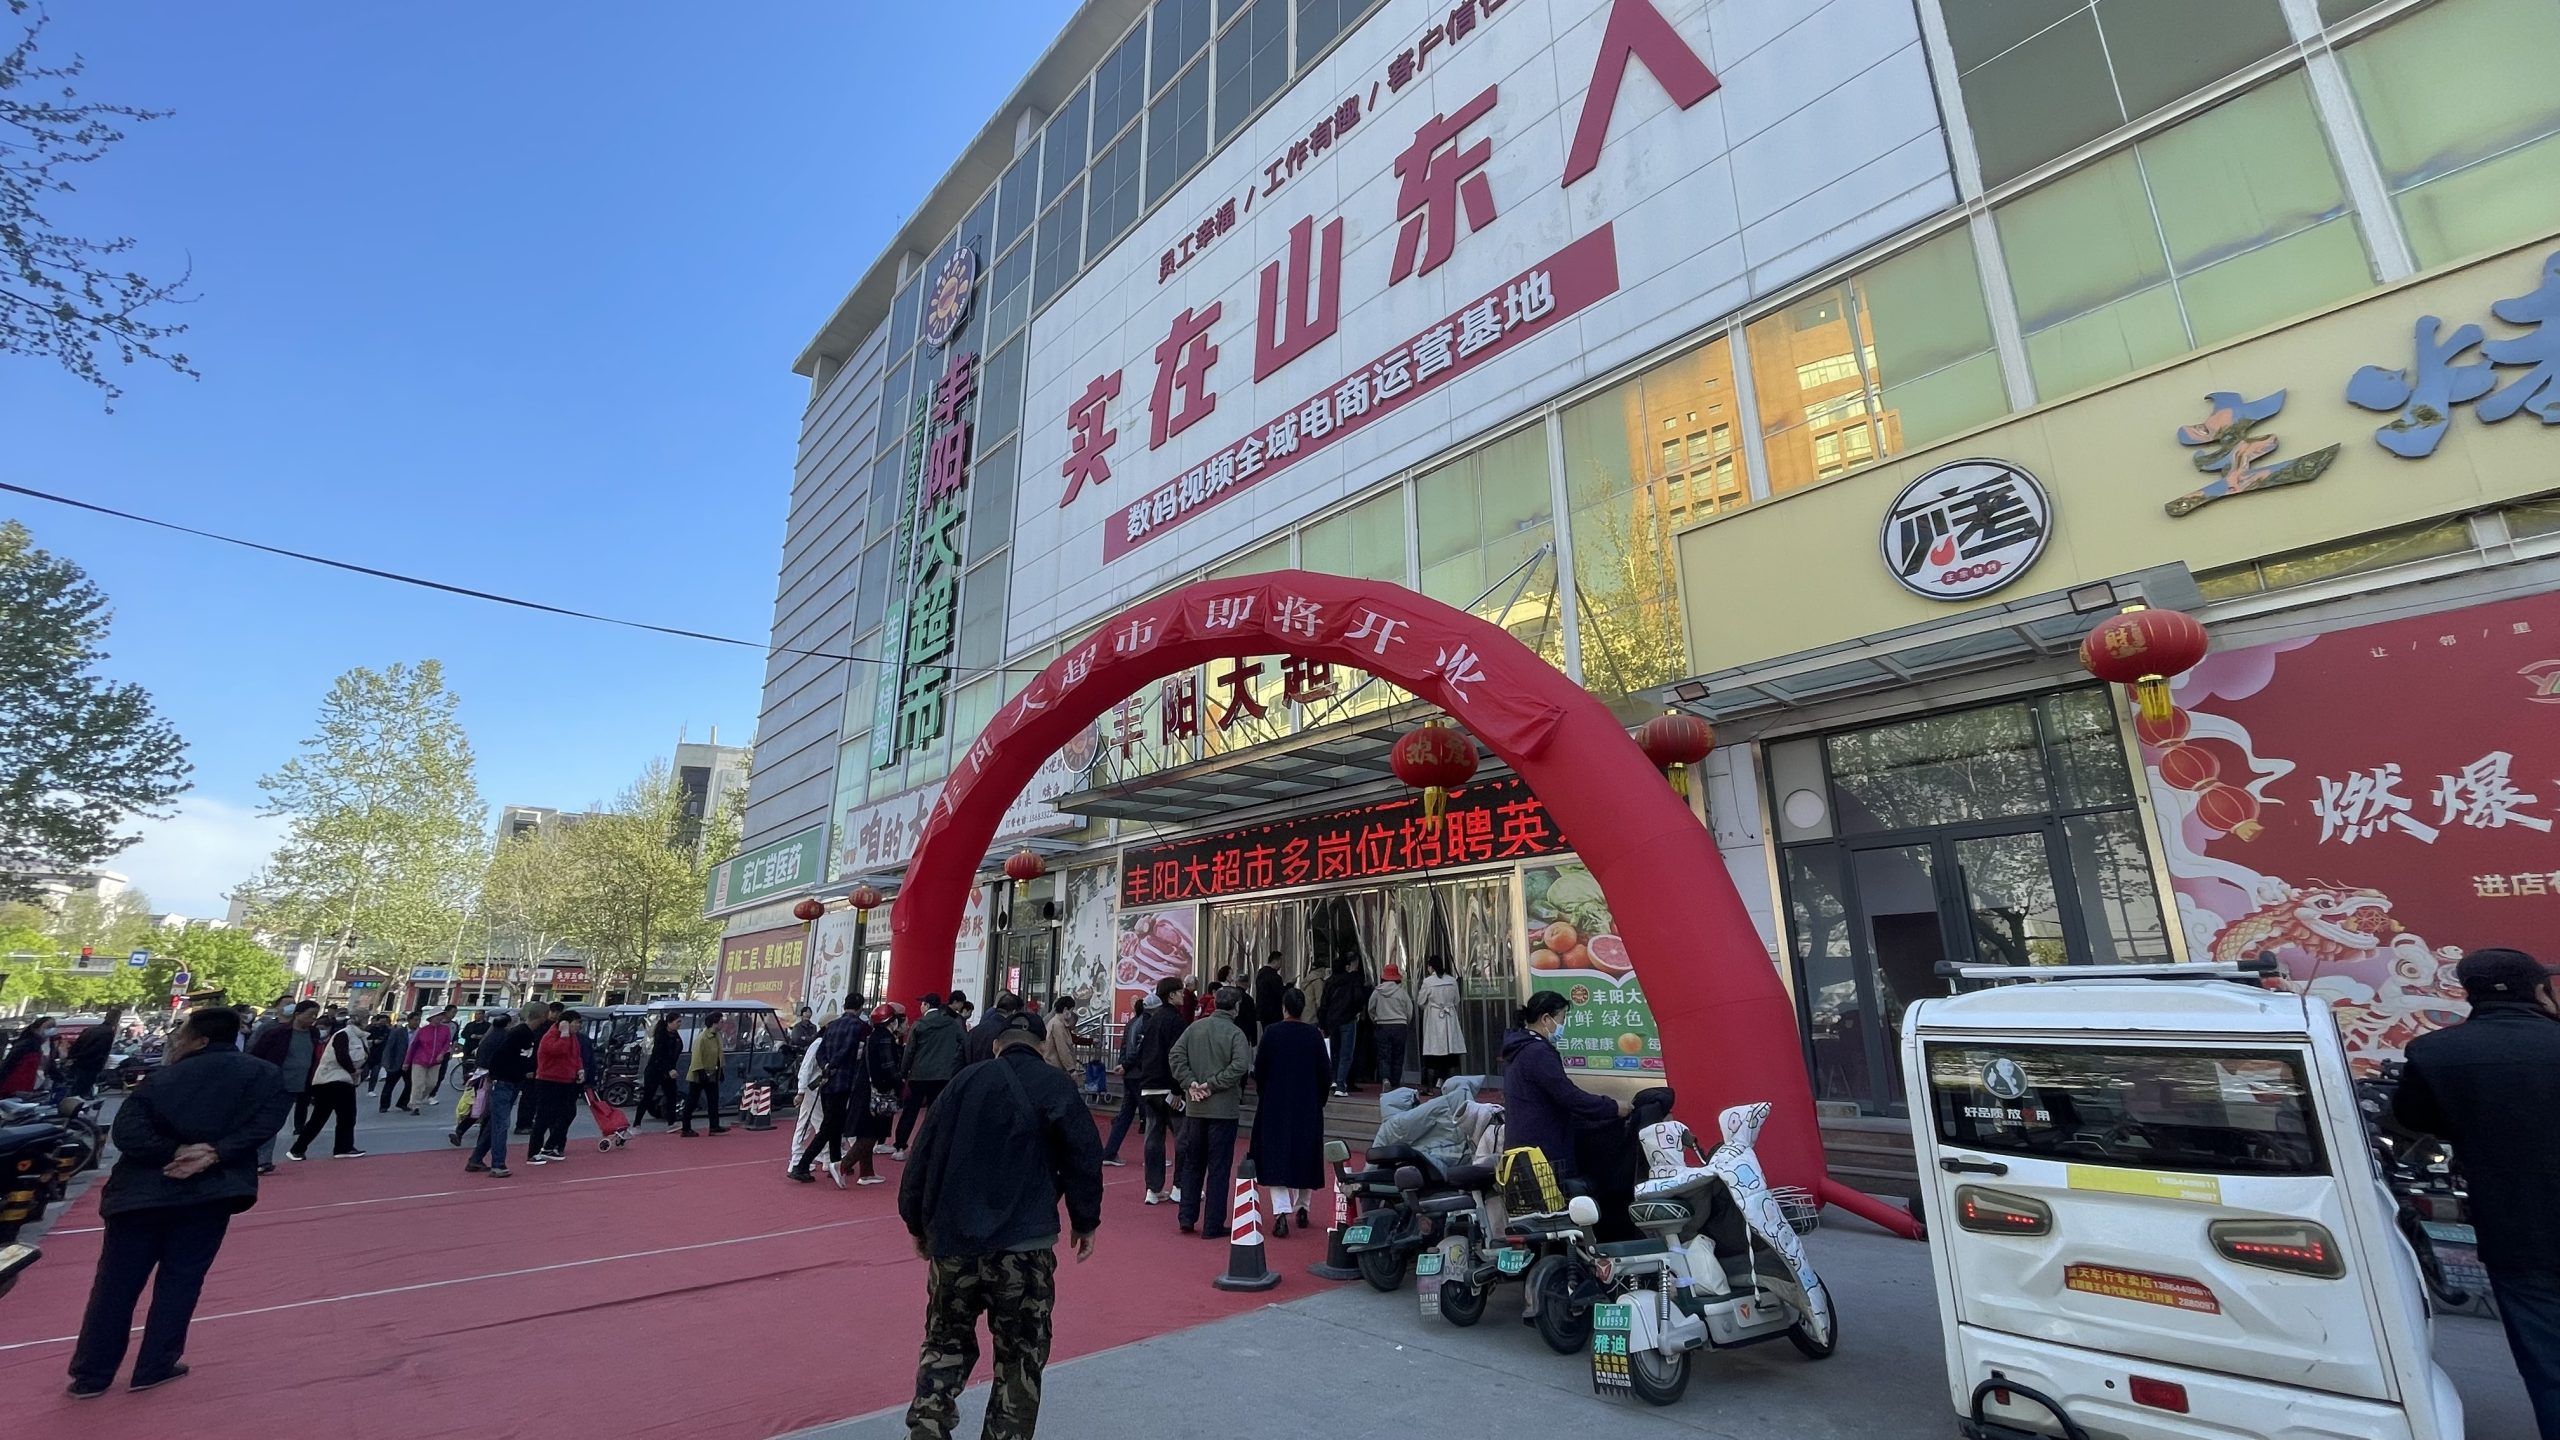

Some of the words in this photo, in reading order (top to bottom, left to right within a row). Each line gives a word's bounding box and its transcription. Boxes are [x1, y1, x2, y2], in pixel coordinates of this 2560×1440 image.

[1060, 0, 1722, 508] 实在山东人
[1126, 270, 1556, 543] 数码视频全域电商运营基地
[899, 350, 972, 750] 丰阳大超市
[872, 614, 901, 757] 生鲜特卖
[2309, 751, 2560, 845] 燃爆
[741, 842, 803, 895] 宏仁堂医药
[1126, 797, 1568, 903] 丰阳大超市多岗位招聘英
[1593, 988, 1648, 1005] 丰阳大
[1601, 1009, 1643, 1027] 绿色
[1556, 1037, 1615, 1051] 自然健康
[1594, 1334, 1627, 1356] 雅迪
